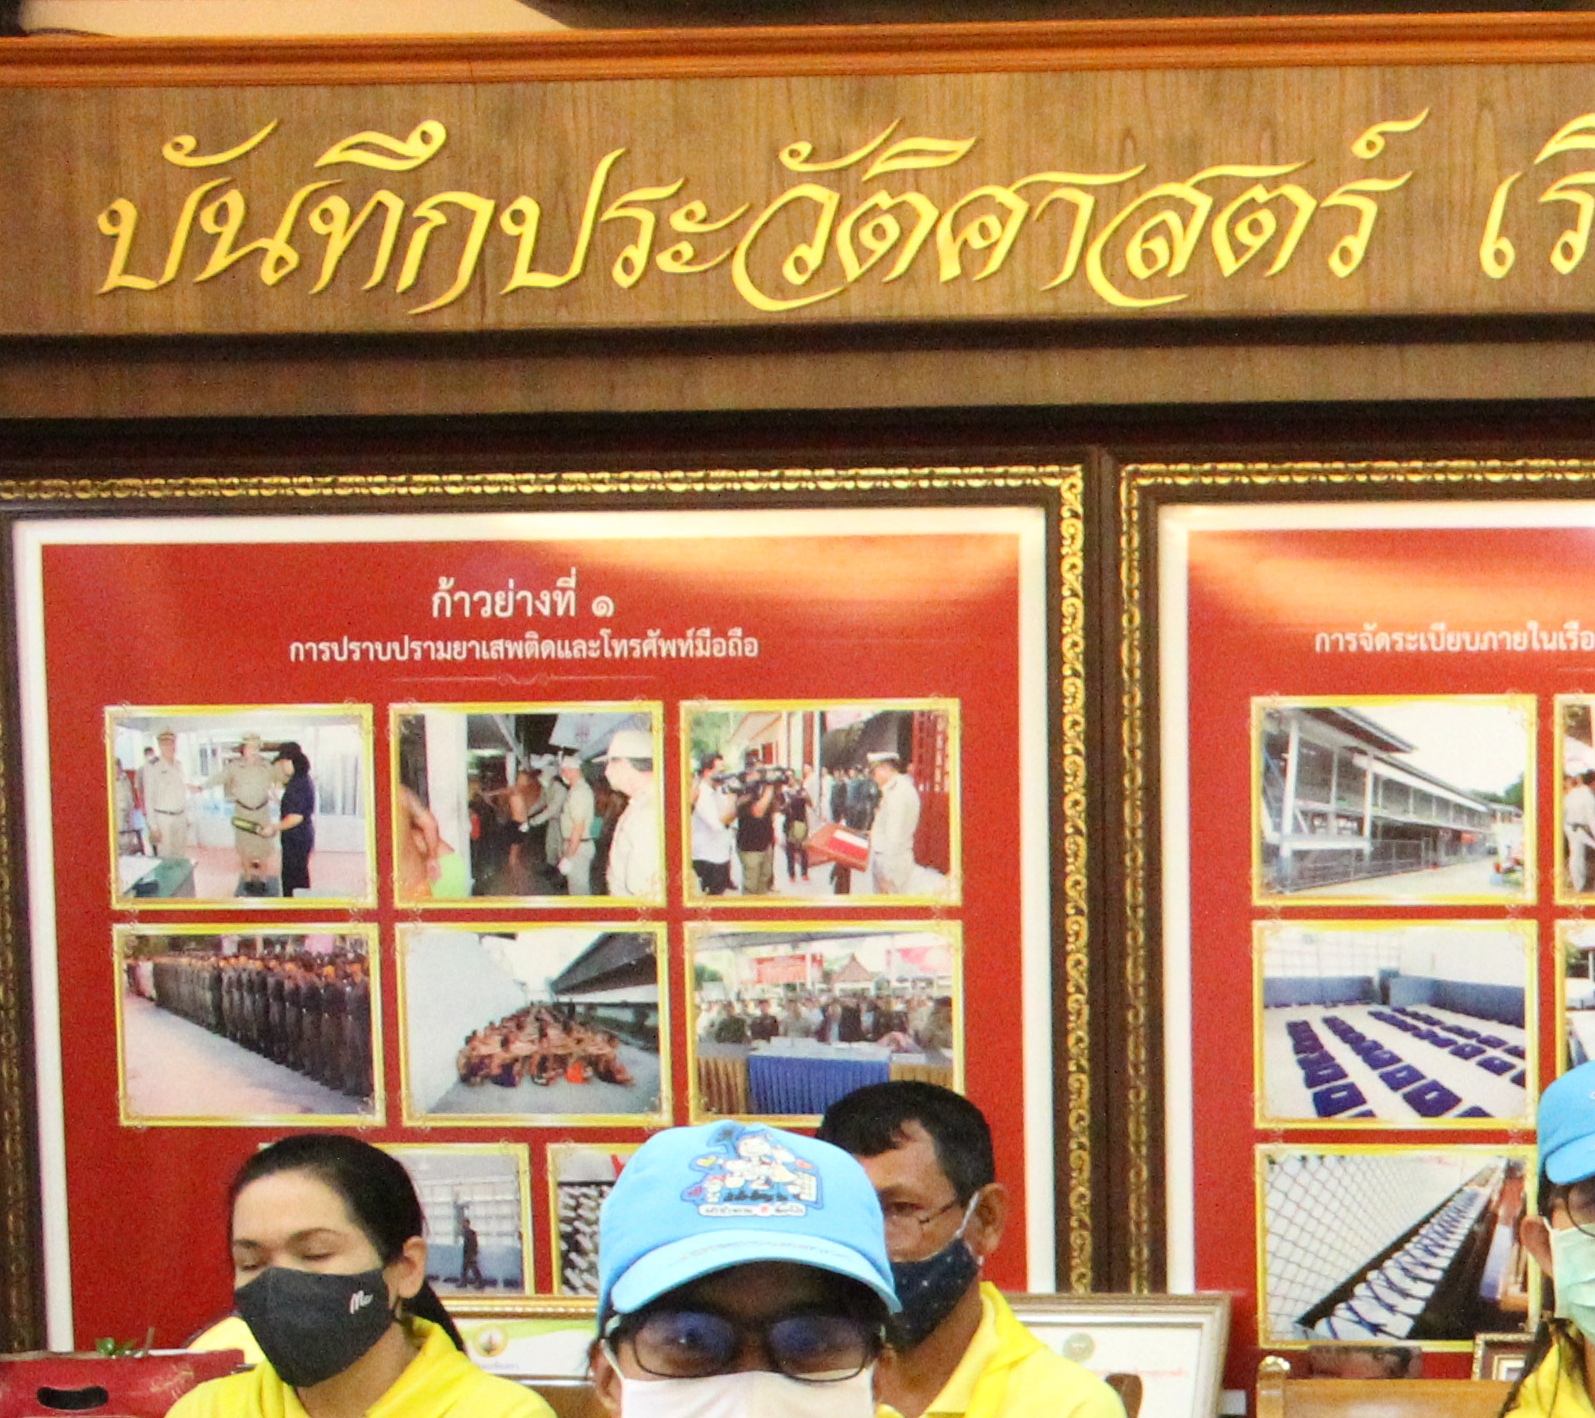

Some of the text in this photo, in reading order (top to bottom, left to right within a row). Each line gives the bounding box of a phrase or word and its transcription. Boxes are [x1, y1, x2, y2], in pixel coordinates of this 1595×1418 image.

[96, 106, 1431, 315] บันทึกประวัติศาสตร์
[430, 566, 615, 618] ก้าวย่างที่ ๑
[288, 626, 760, 663] การปราบปรามยาเสพติดและโทรศัพท์มือถือ
